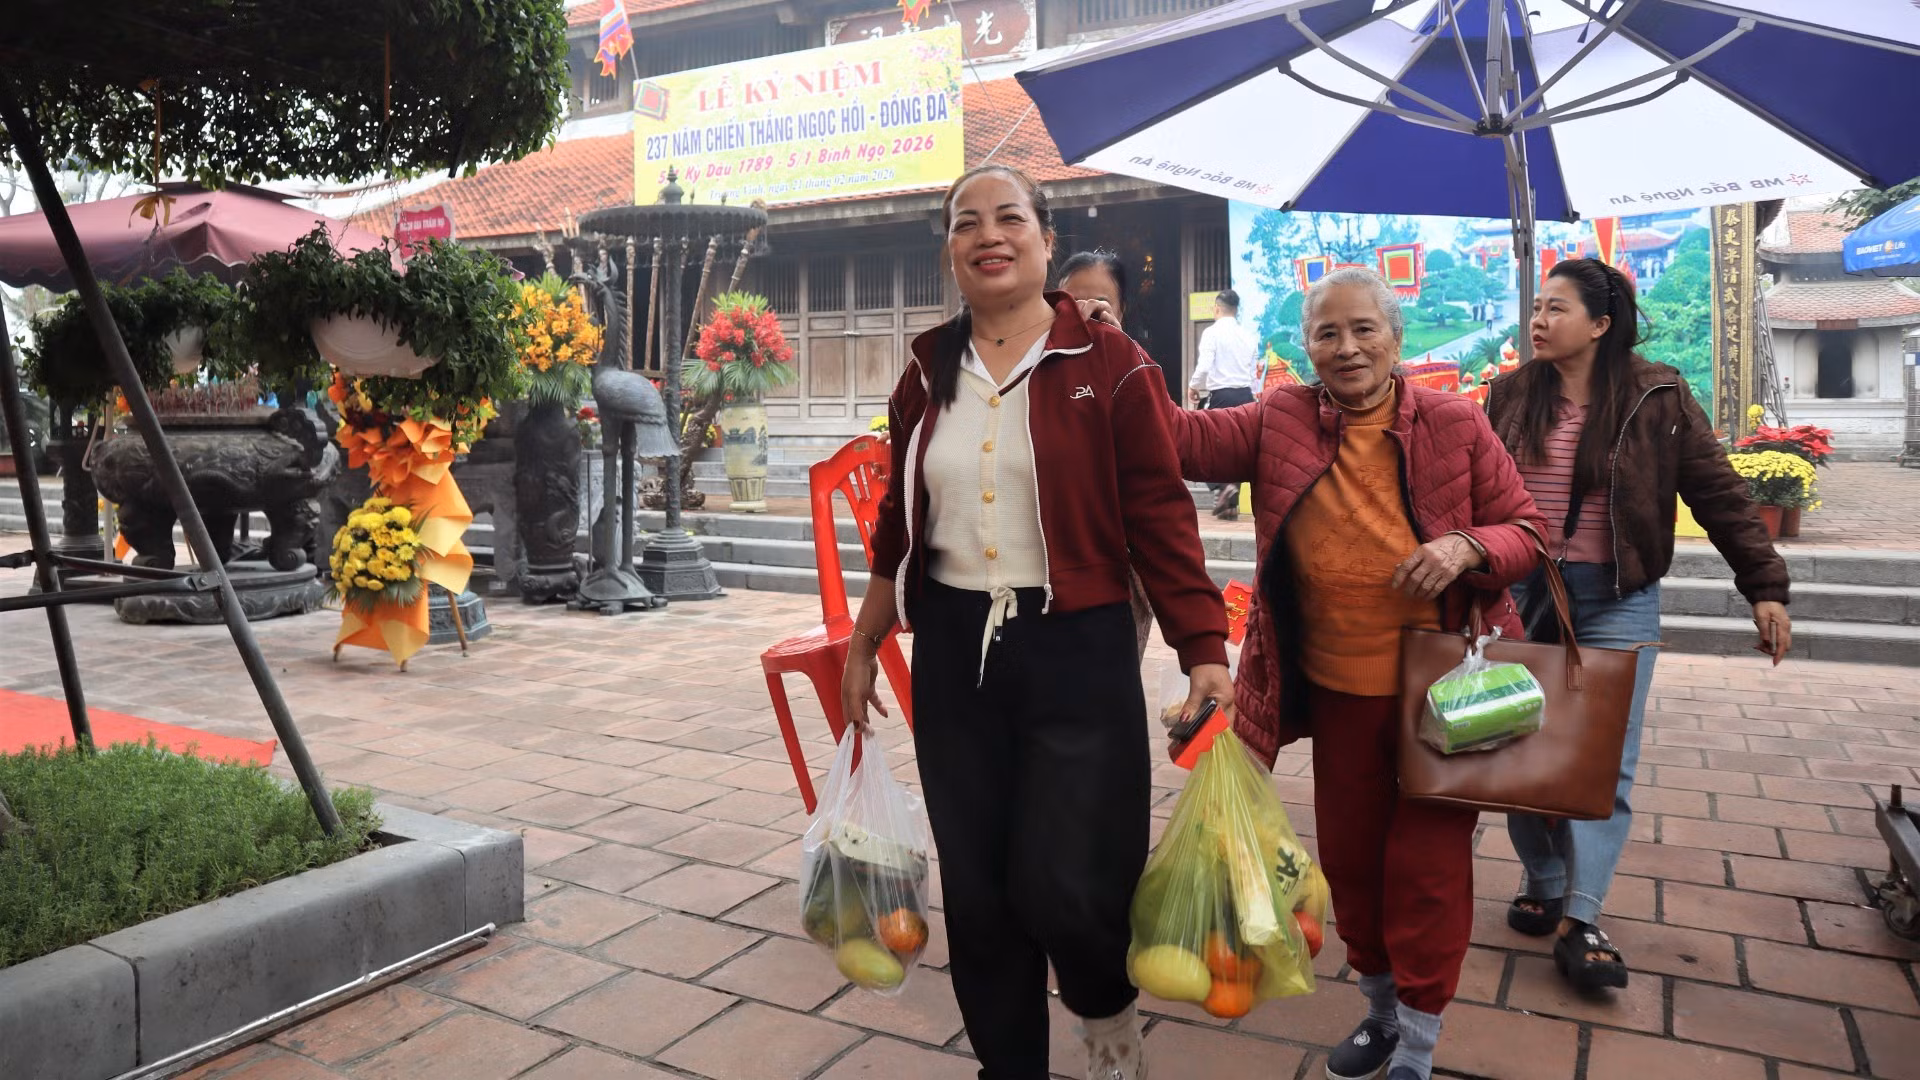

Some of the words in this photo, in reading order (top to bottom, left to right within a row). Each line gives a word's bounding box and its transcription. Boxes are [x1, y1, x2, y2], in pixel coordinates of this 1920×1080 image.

[699, 75, 733, 112] LỄ
[744, 69, 783, 105] KỶ
[794, 60, 881, 99] NIỆM
[646, 134, 669, 161] 237
[672, 127, 702, 157] NĂM
[705, 116, 745, 152] CHIẾN
[748, 108, 793, 146] THẮNG
[798, 109, 836, 143] NGỌC
[879, 88, 922, 128] ĐỐNG
[926, 92, 948, 122] ĐA
[738, 155, 774, 175] 1789
[857, 143, 886, 163] Ngọ
[892, 134, 934, 155] 2026
